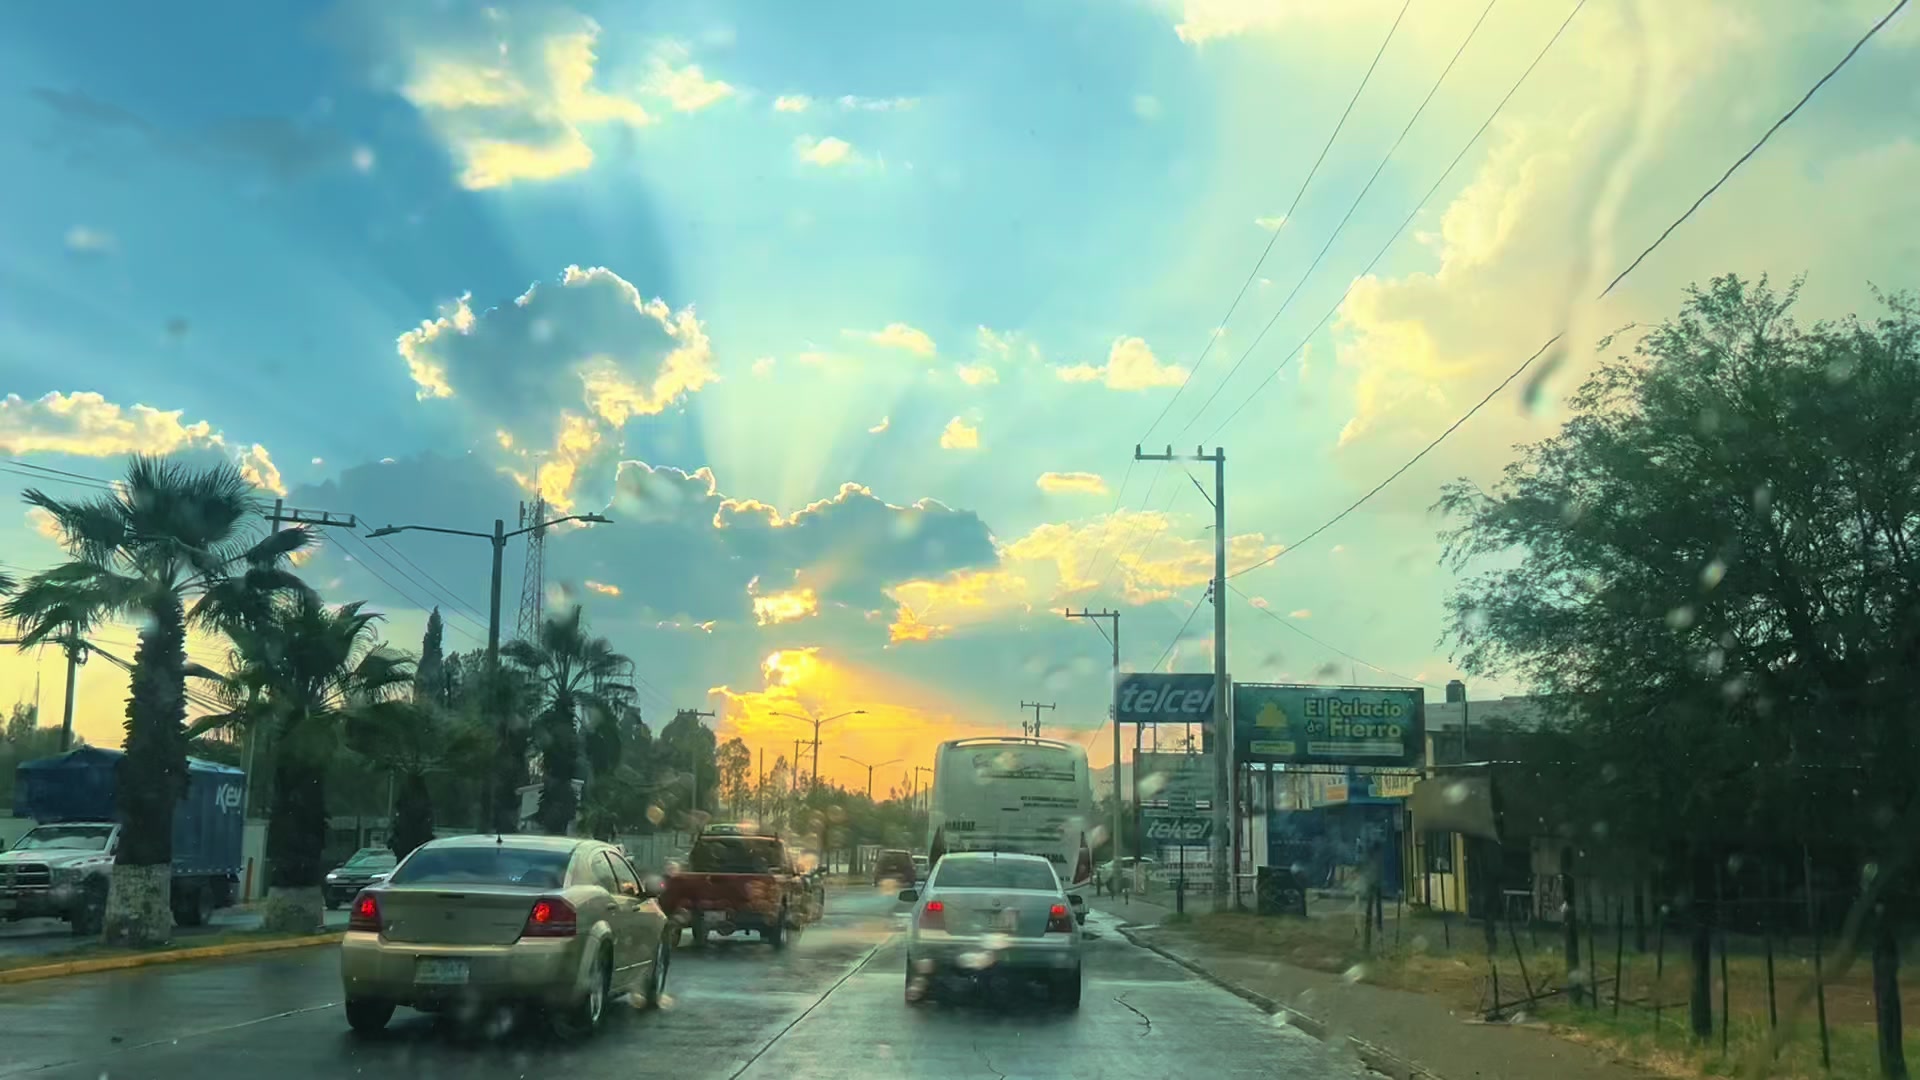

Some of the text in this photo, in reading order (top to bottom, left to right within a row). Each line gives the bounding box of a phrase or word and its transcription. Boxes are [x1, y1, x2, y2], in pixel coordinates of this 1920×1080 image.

[1121, 683, 1216, 713] telcel
[1305, 698, 1402, 717] El Palacio
[1307, 718, 1402, 738] de Fierro
